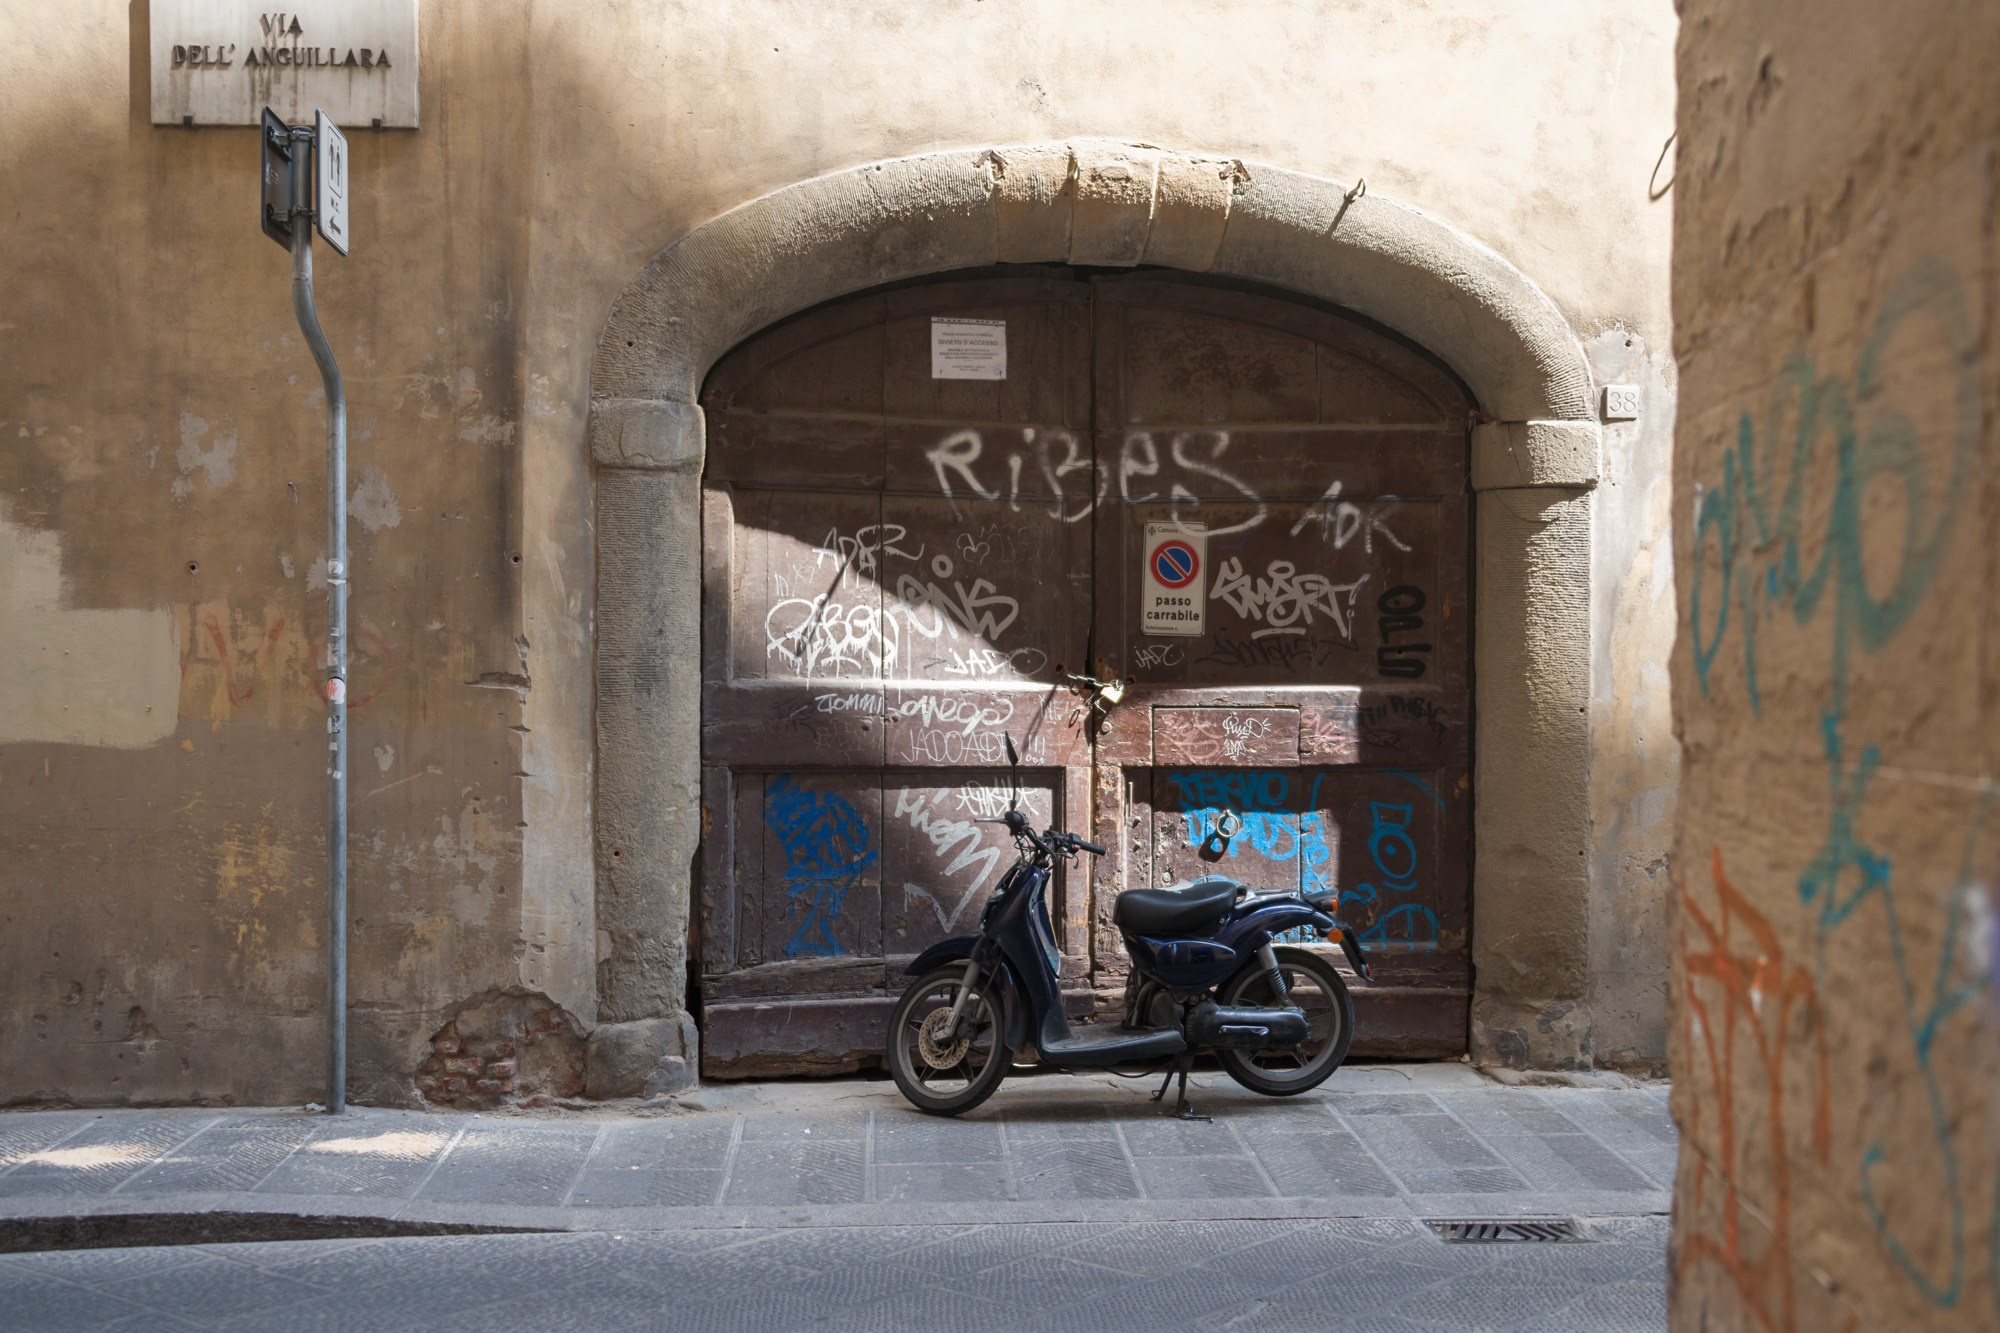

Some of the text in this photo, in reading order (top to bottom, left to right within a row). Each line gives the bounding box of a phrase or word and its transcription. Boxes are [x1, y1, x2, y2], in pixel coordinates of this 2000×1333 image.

[260, 13, 303, 34] VIA
[173, 43, 391, 67] DELL' ANGUILLARA
[1609, 391, 1636, 413] 38
[1156, 597, 1191, 607] passo
[1147, 610, 1200, 621] carrabile
